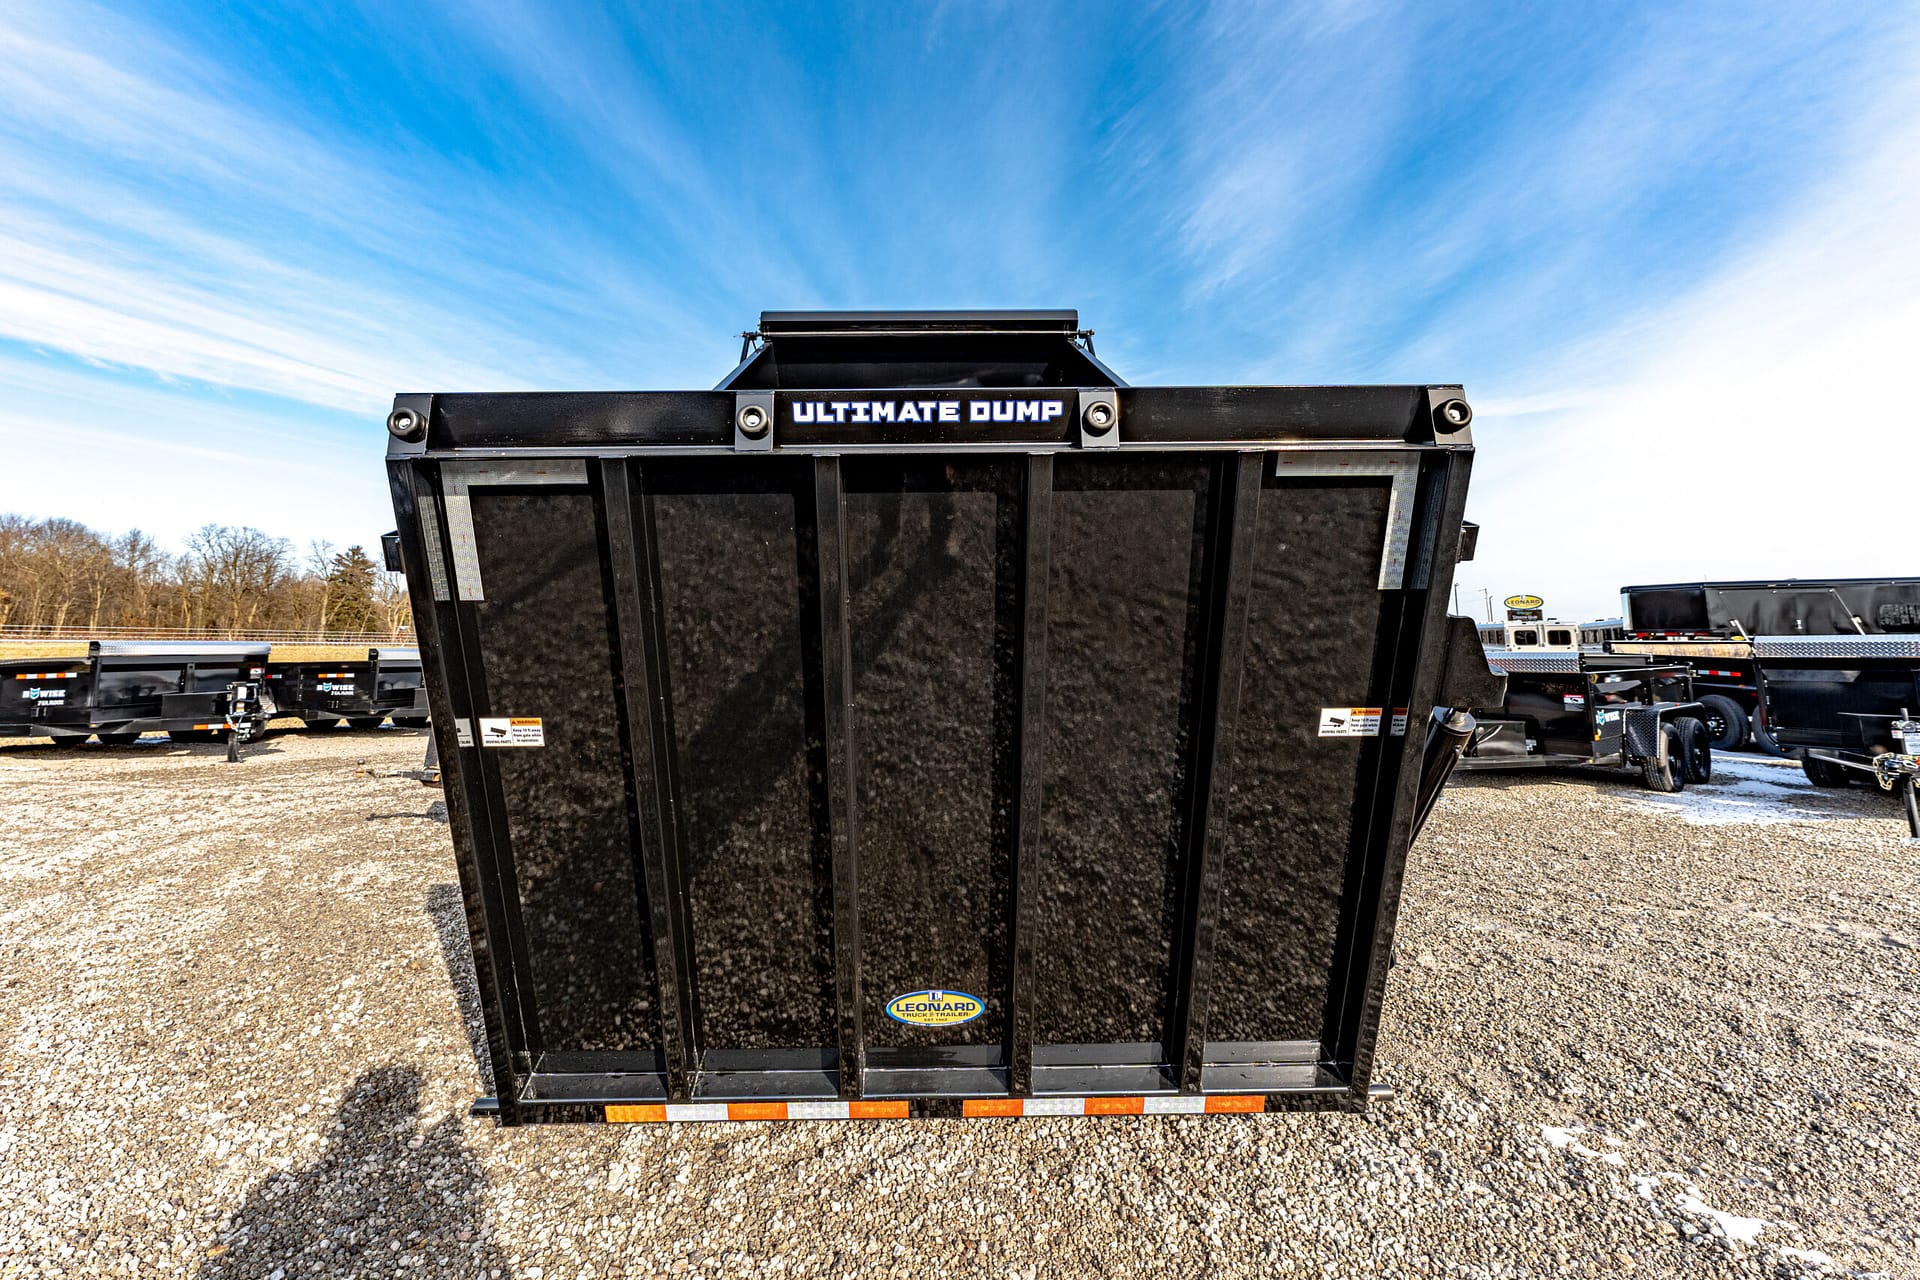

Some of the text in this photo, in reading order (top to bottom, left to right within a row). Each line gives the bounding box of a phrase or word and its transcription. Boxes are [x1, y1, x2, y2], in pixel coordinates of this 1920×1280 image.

[792, 400, 1064, 423] ULTIMATE DUMP
[896, 1002, 976, 1012] LEONARD
